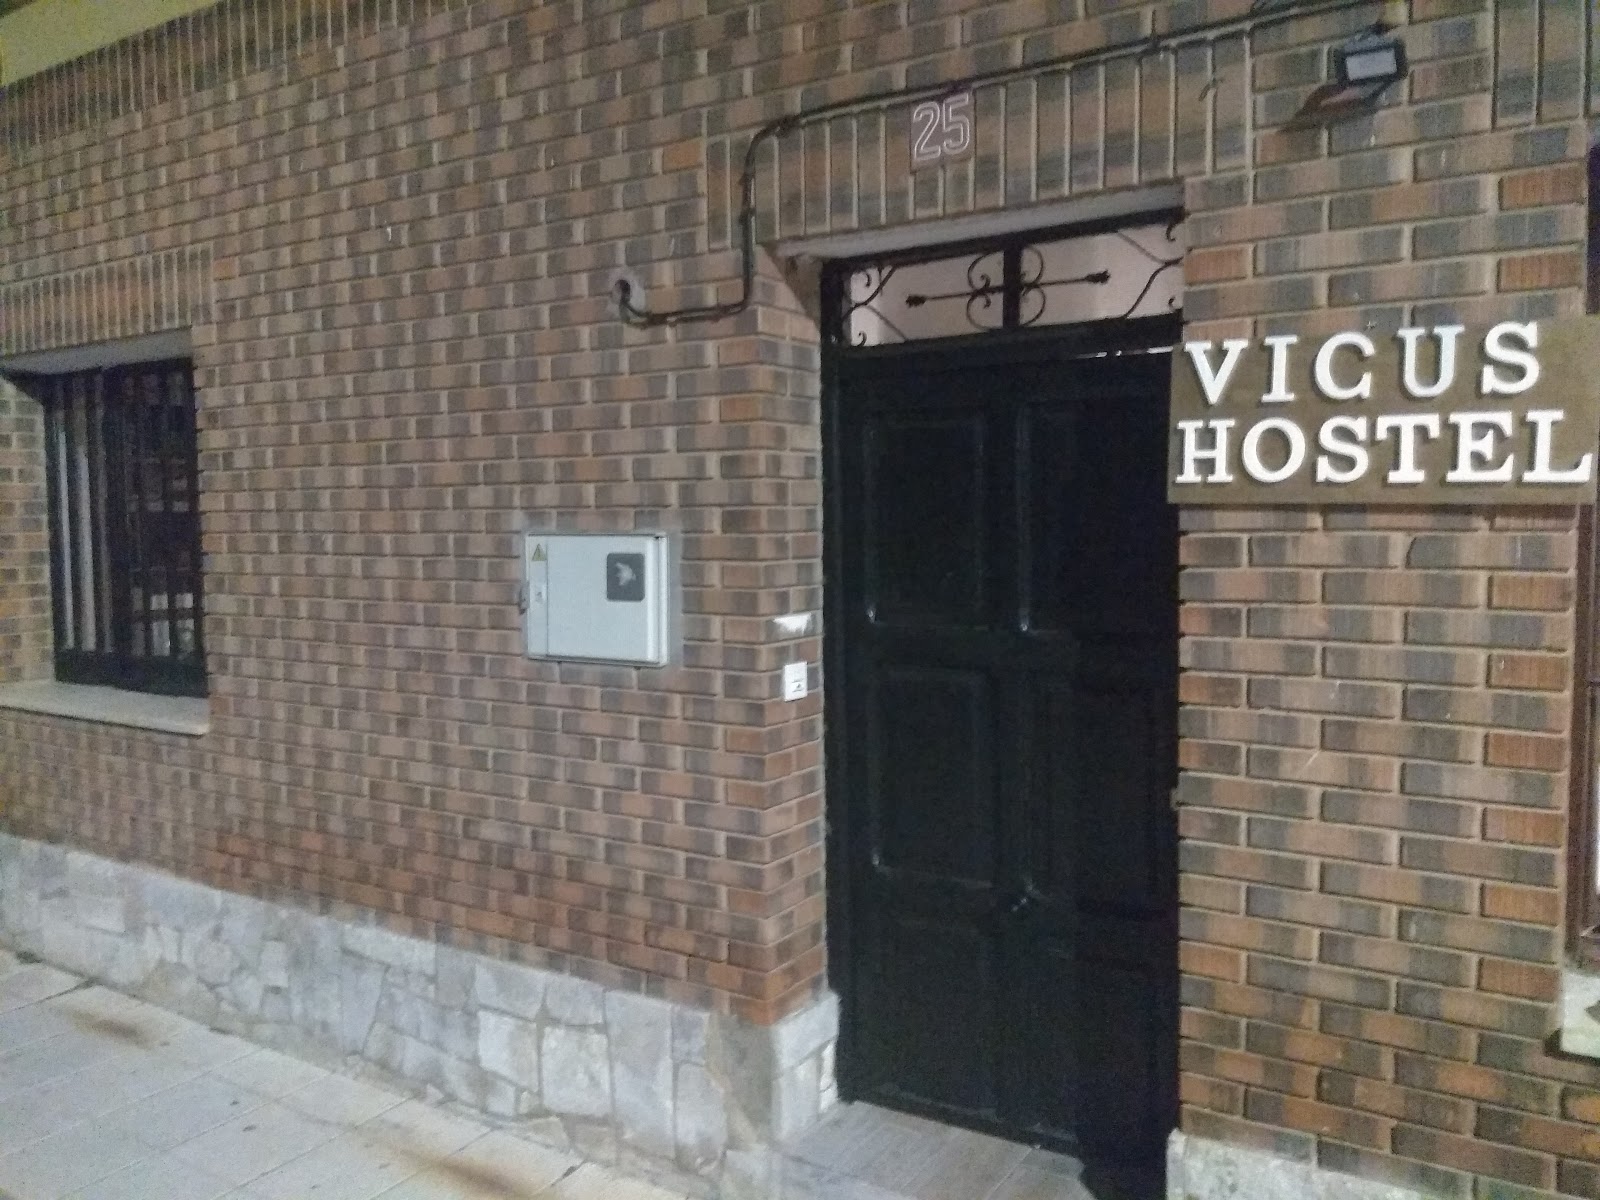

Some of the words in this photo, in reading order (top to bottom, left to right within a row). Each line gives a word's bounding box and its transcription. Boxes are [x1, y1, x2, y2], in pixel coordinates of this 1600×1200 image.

[913, 92, 970, 161] 25
[1184, 320, 1540, 405] VICUS
[1175, 409, 1593, 484] HOSTEL
